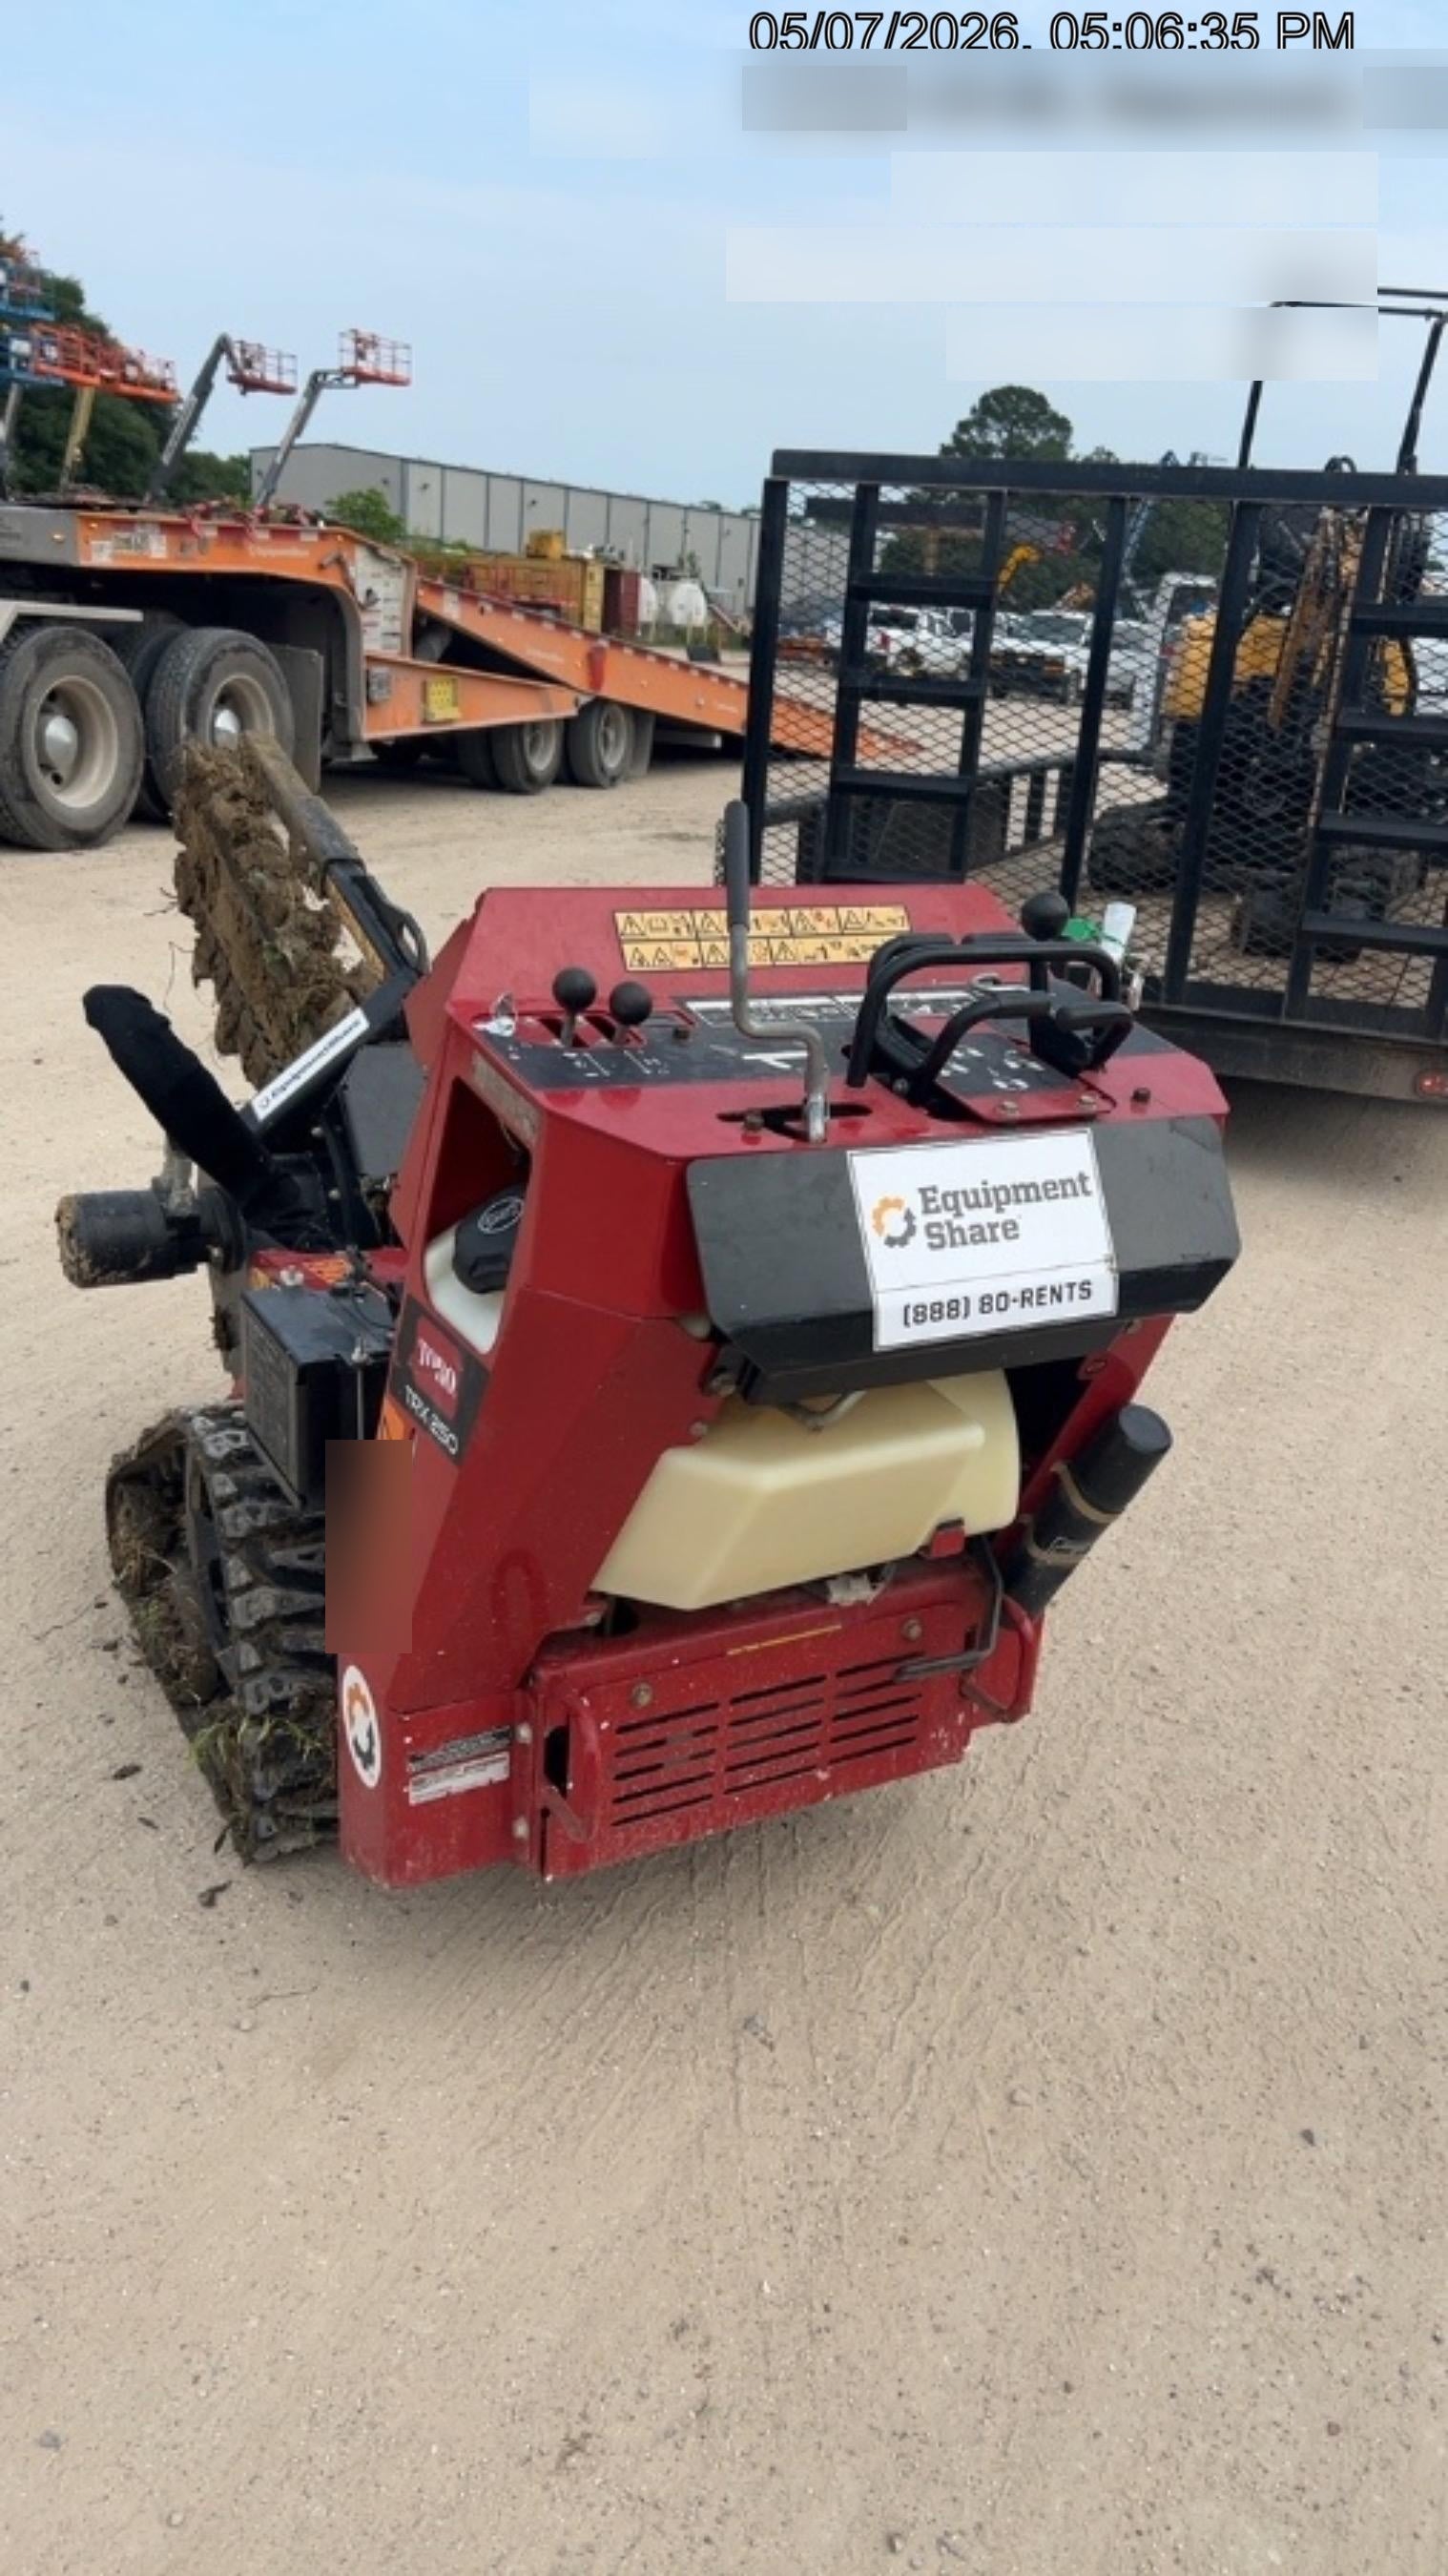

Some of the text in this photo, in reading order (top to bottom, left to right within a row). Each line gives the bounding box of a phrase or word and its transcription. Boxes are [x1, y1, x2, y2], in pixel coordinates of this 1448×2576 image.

[918, 1171, 1092, 1217] Equipment
[924, 1218, 1021, 1251] Share
[902, 1278, 1093, 1328] (888) 80-RENTS
